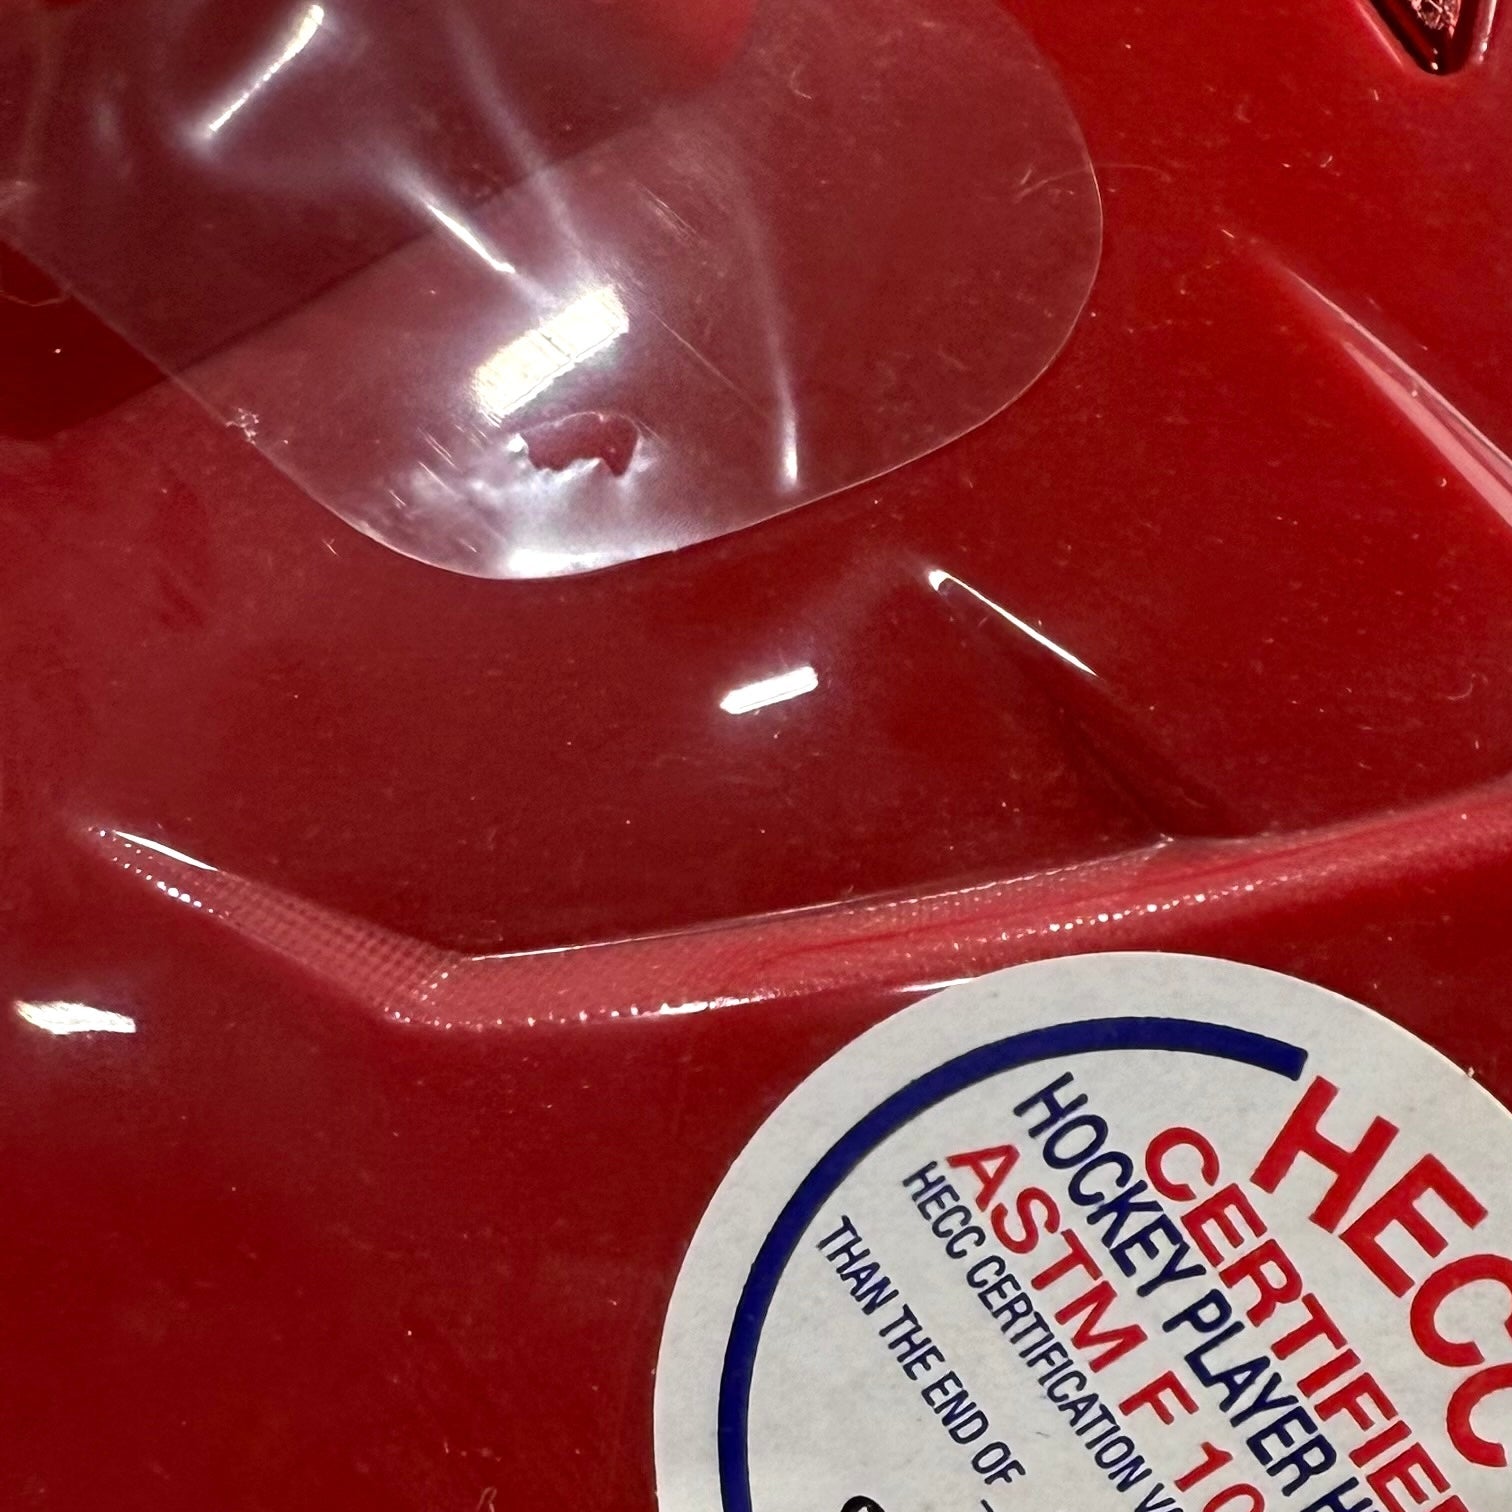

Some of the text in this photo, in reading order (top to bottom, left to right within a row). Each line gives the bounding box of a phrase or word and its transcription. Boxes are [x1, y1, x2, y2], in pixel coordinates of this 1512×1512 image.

[816, 1215, 899, 1315] THAN
[879, 1304, 945, 1380] THE
[921, 1371, 989, 1444] END
[971, 1442, 1025, 1485] OF
[902, 1161, 986, 1259] HECC
[966, 1255, 1152, 1492] CERTIFICATION
[946, 1144, 1147, 1373] ASTM
[1119, 1371, 1199, 1425] F
[1013, 1072, 1206, 1297] HOCKEY
[1162, 1289, 1336, 1497] PLAYER
